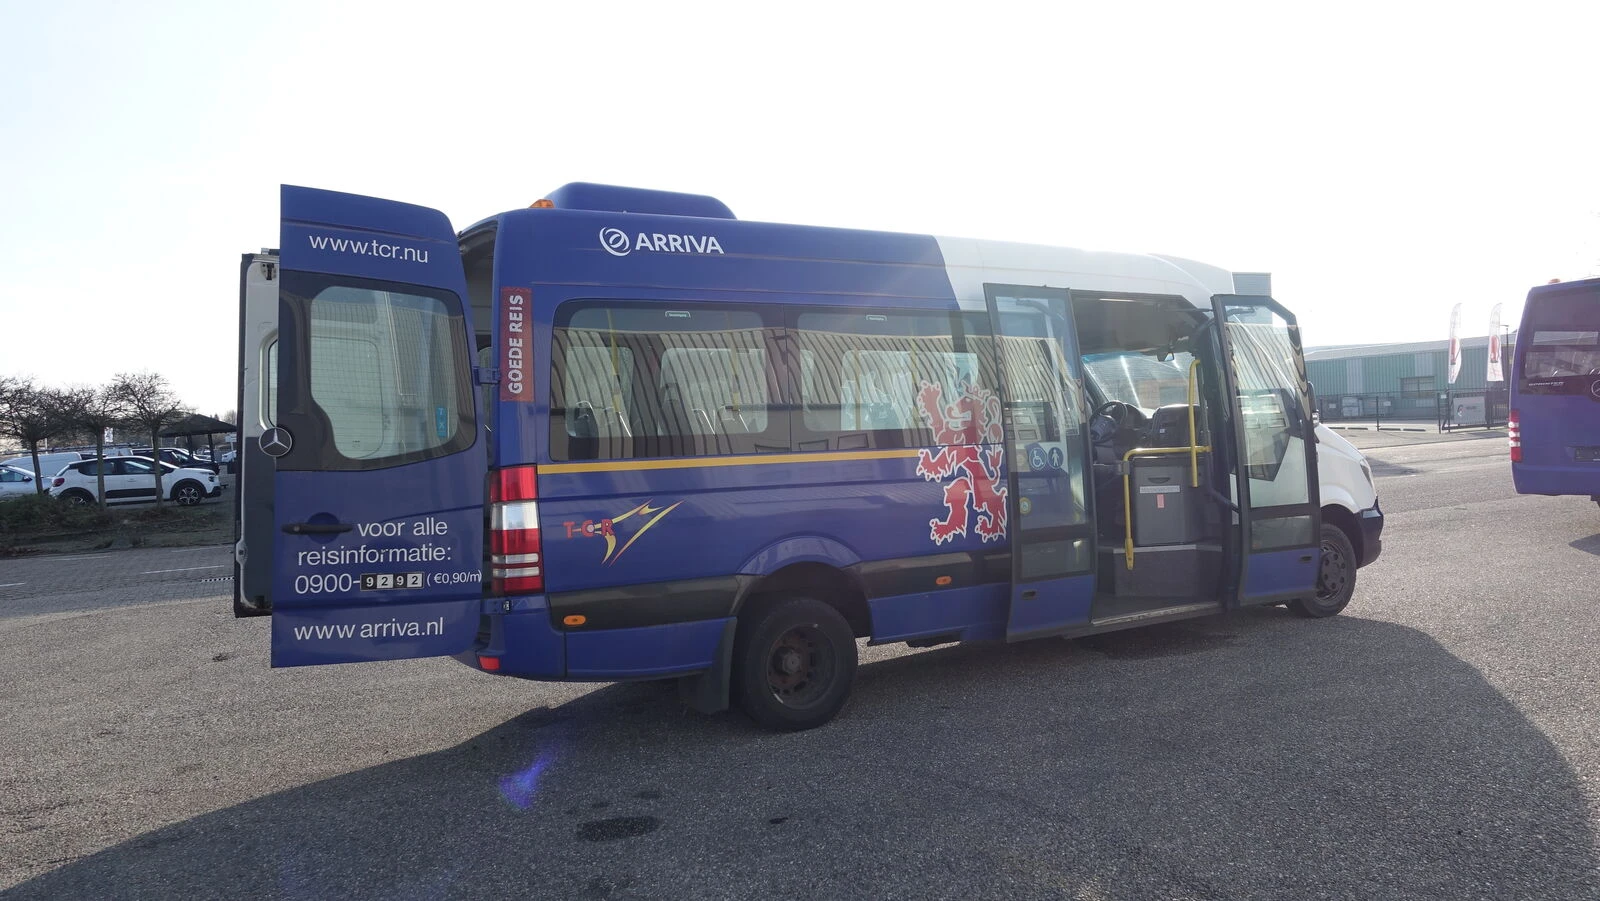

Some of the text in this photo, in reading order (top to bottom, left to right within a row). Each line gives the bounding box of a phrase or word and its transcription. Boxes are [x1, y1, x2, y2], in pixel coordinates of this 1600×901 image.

[308, 233, 429, 264] www.tcr.nu
[634, 232, 725, 255] ARRIVA
[508, 294, 524, 395] GOEDE REIS
[357, 517, 448, 538] voor alle
[297, 543, 452, 567] reisinformatie:
